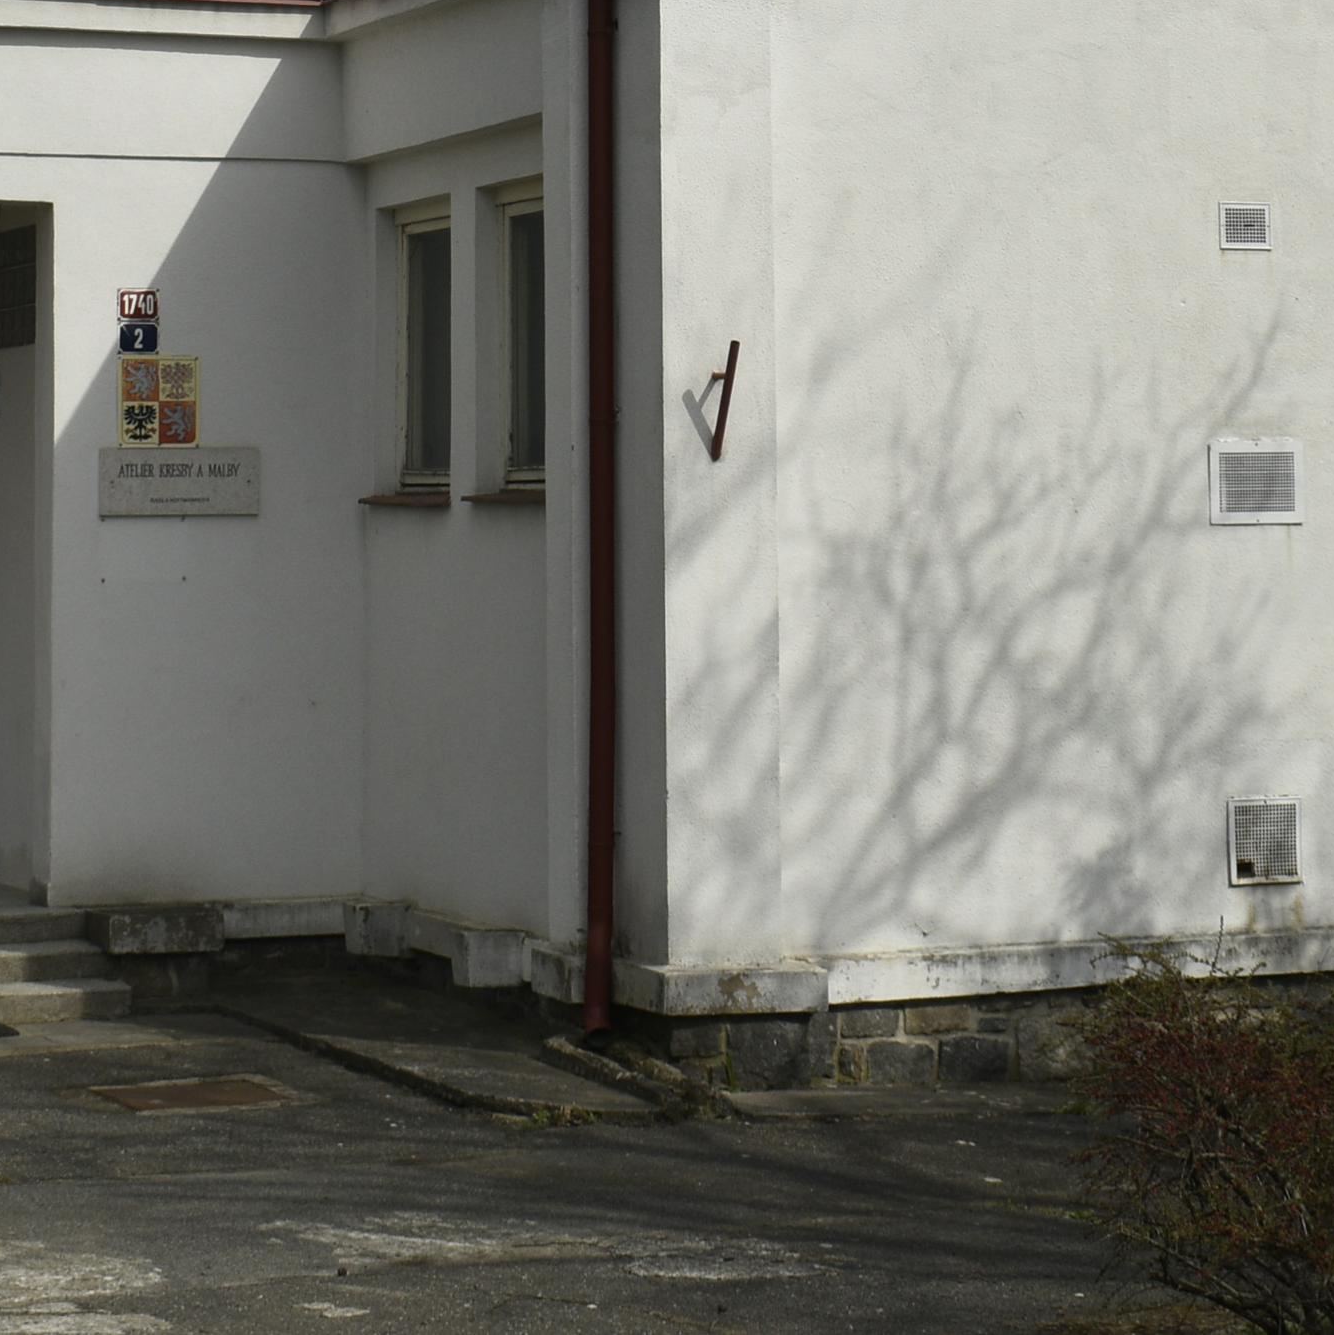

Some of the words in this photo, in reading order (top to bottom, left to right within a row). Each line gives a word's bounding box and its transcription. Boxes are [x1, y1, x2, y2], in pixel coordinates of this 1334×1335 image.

[123, 294, 154, 315] 1740
[134, 328, 143, 349] 2
[159, 462, 194, 478] KRESBY
[197, 464, 204, 478] A
[208, 462, 241, 478] MALBY
